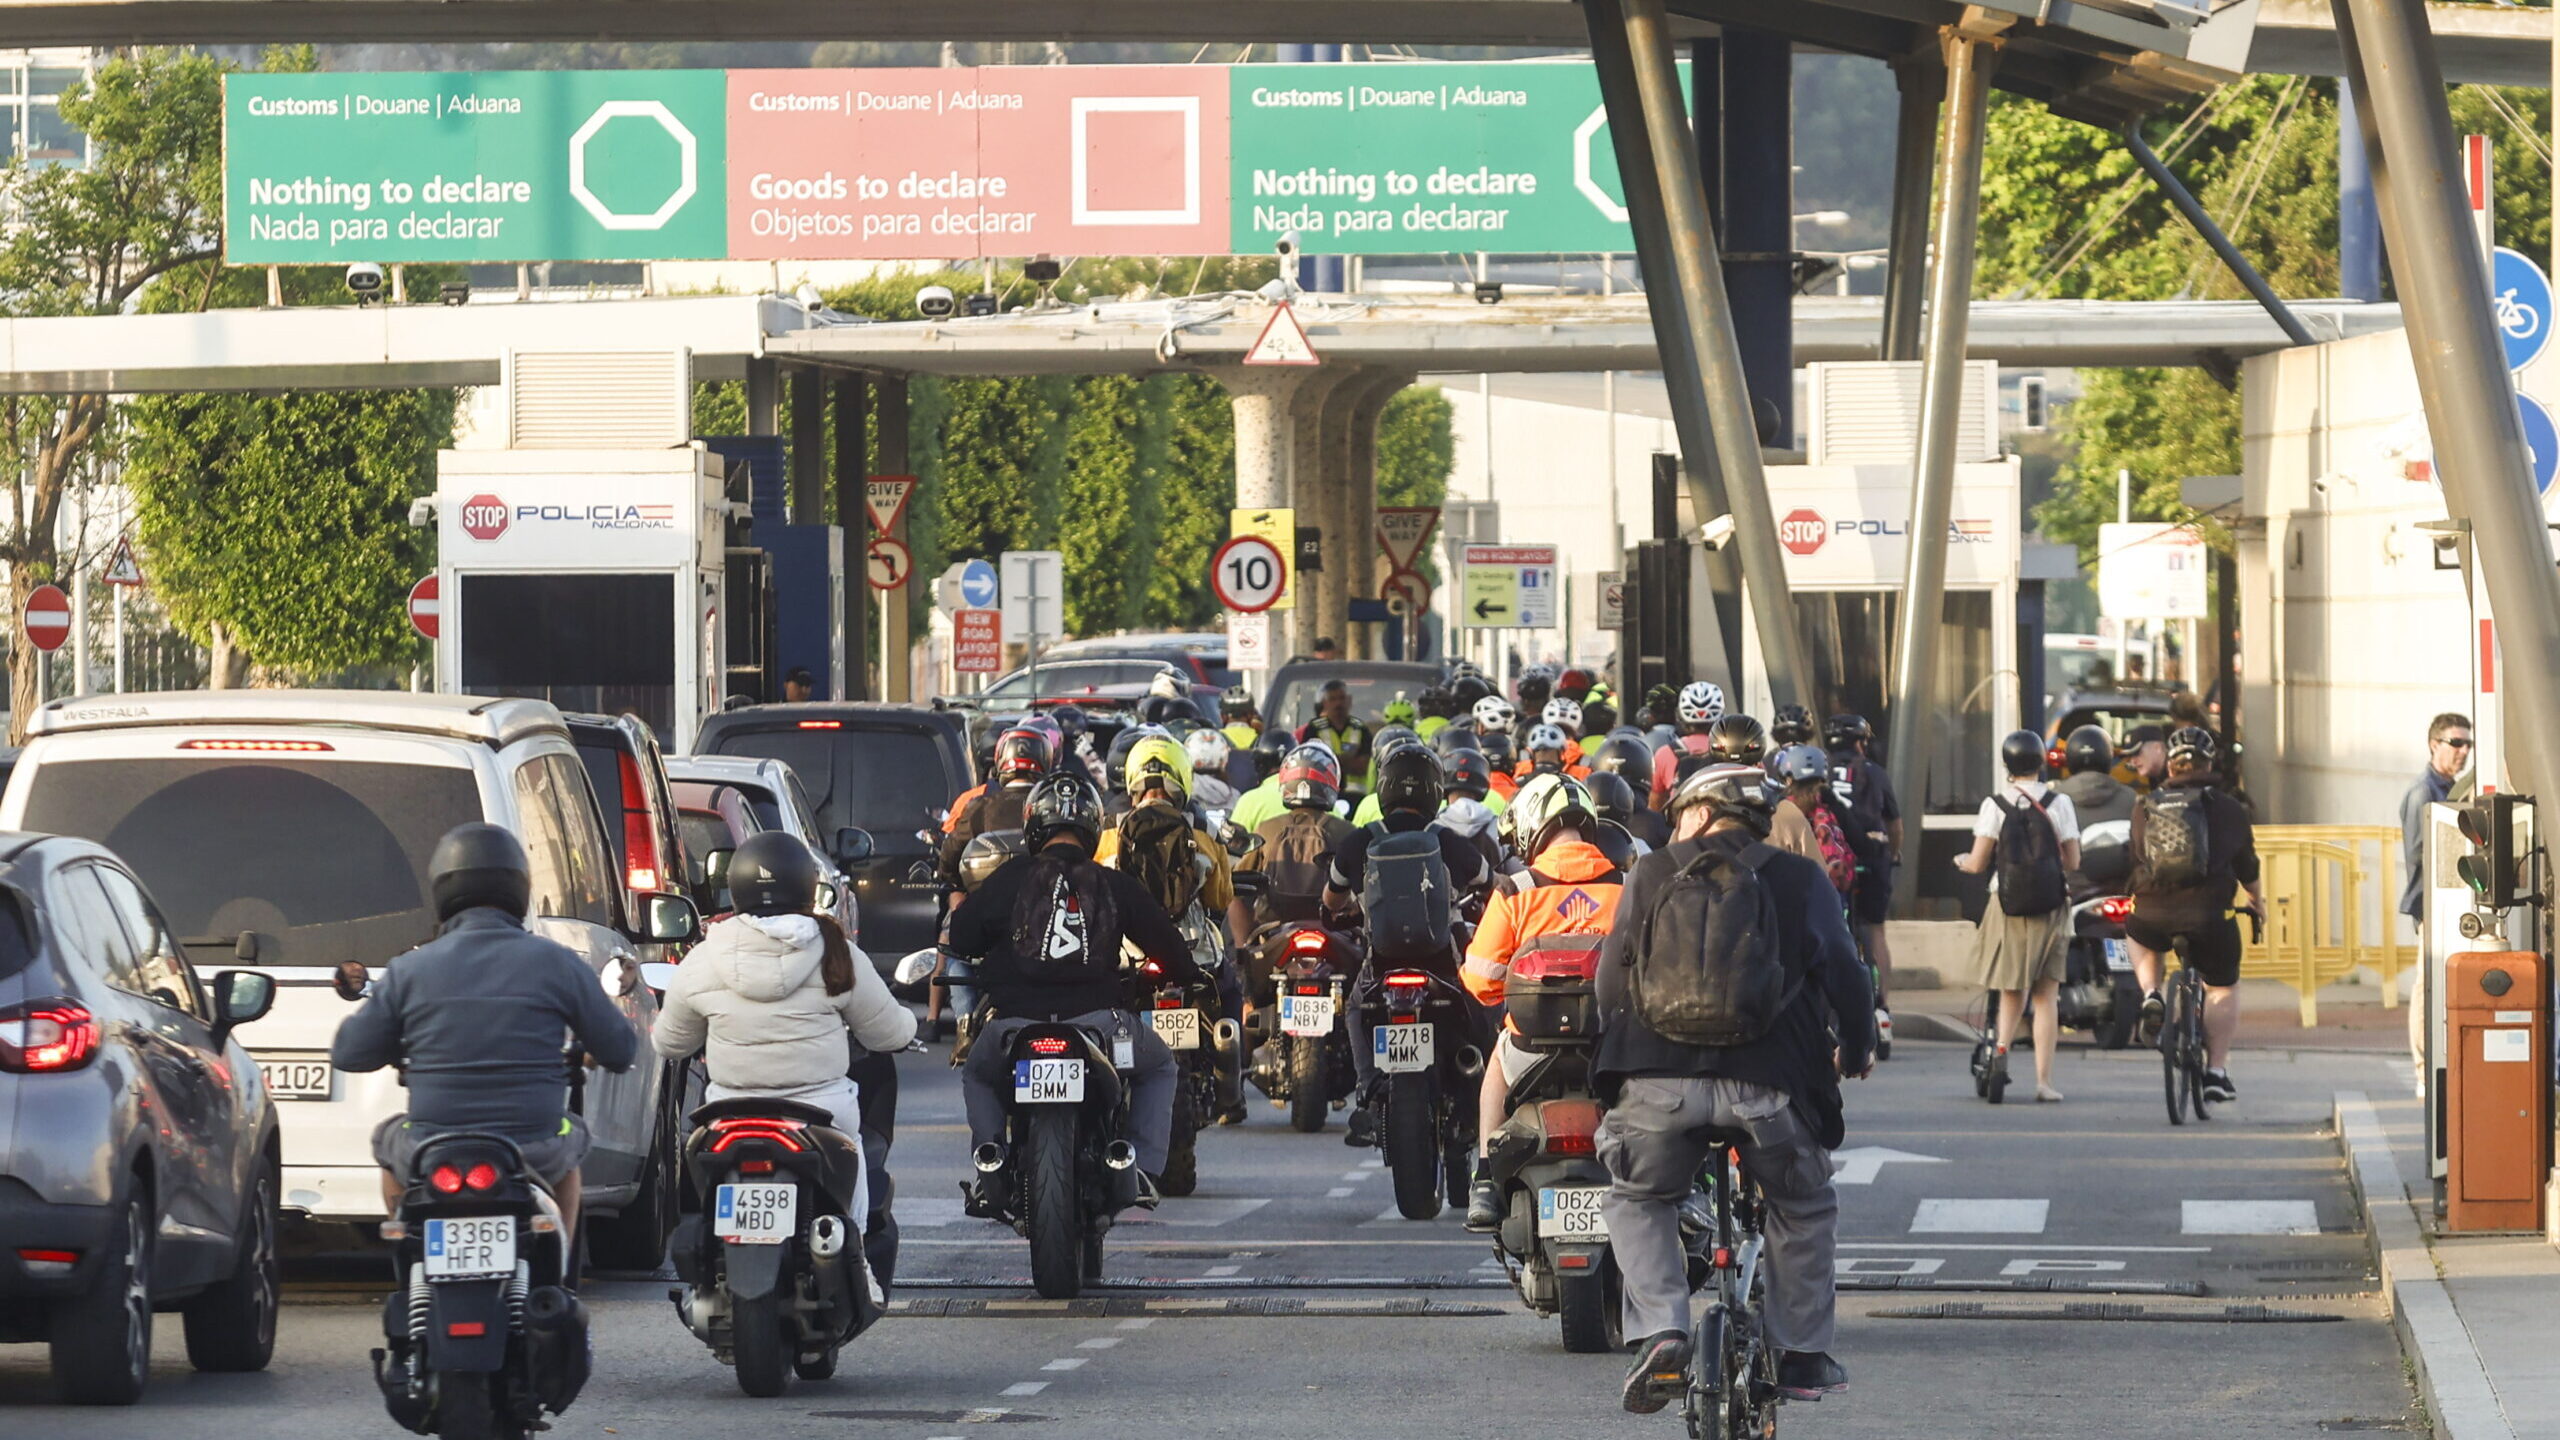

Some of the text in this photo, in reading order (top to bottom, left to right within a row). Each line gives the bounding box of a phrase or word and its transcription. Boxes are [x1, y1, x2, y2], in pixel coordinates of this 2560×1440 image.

[248, 94, 521, 116] Customs Douane Aduana
[749, 90, 1023, 111] Customs Douane Aduana
[1251, 86, 1527, 106] Customs Douane Aduana
[249, 175, 531, 210] Nothing to declare
[750, 171, 1007, 200] Goods to declare
[1252, 167, 1536, 202] Nothing to declare
[250, 212, 504, 246] Nada para declarar
[750, 207, 1037, 242] Objetos para declarar
[1253, 204, 1509, 237] Nada para declarar
[867, 483, 903, 496] GIVE
[516, 505, 641, 520] POLICIA
[875, 499, 898, 508] WAY
[465, 505, 506, 529] STOP
[592, 520, 674, 529] NACIONAL
[1382, 514, 1422, 529] GIVE
[1389, 530, 1419, 541] WAY
[1782, 520, 1825, 543] STOP
[1835, 520, 1960, 535] POLIA
[1228, 556, 1272, 591] 10
[963, 613, 991, 625] NEW
[961, 627, 994, 639] ROAD
[955, 642, 999, 655] LAYOUT
[957, 657, 997, 669] AHEAD
[63, 706, 150, 720] WESTFALIA
[1294, 1000, 1329, 1013] 0636
[1155, 1013, 1195, 1030] 5662
[1294, 1014, 1319, 1027] NBV
[1388, 1027, 1430, 1046] 2718
[1388, 1045, 1419, 1063] MMK
[262, 1065, 325, 1089] 1102
[1032, 1063, 1080, 1080] 0713
[1031, 1082, 1067, 1099] BMM
[736, 1190, 789, 1209] 4598
[735, 1211, 775, 1230] MBD
[1563, 1212, 1601, 1232] GSF
[446, 1221, 509, 1244] 3366
[446, 1245, 493, 1269] HFR
